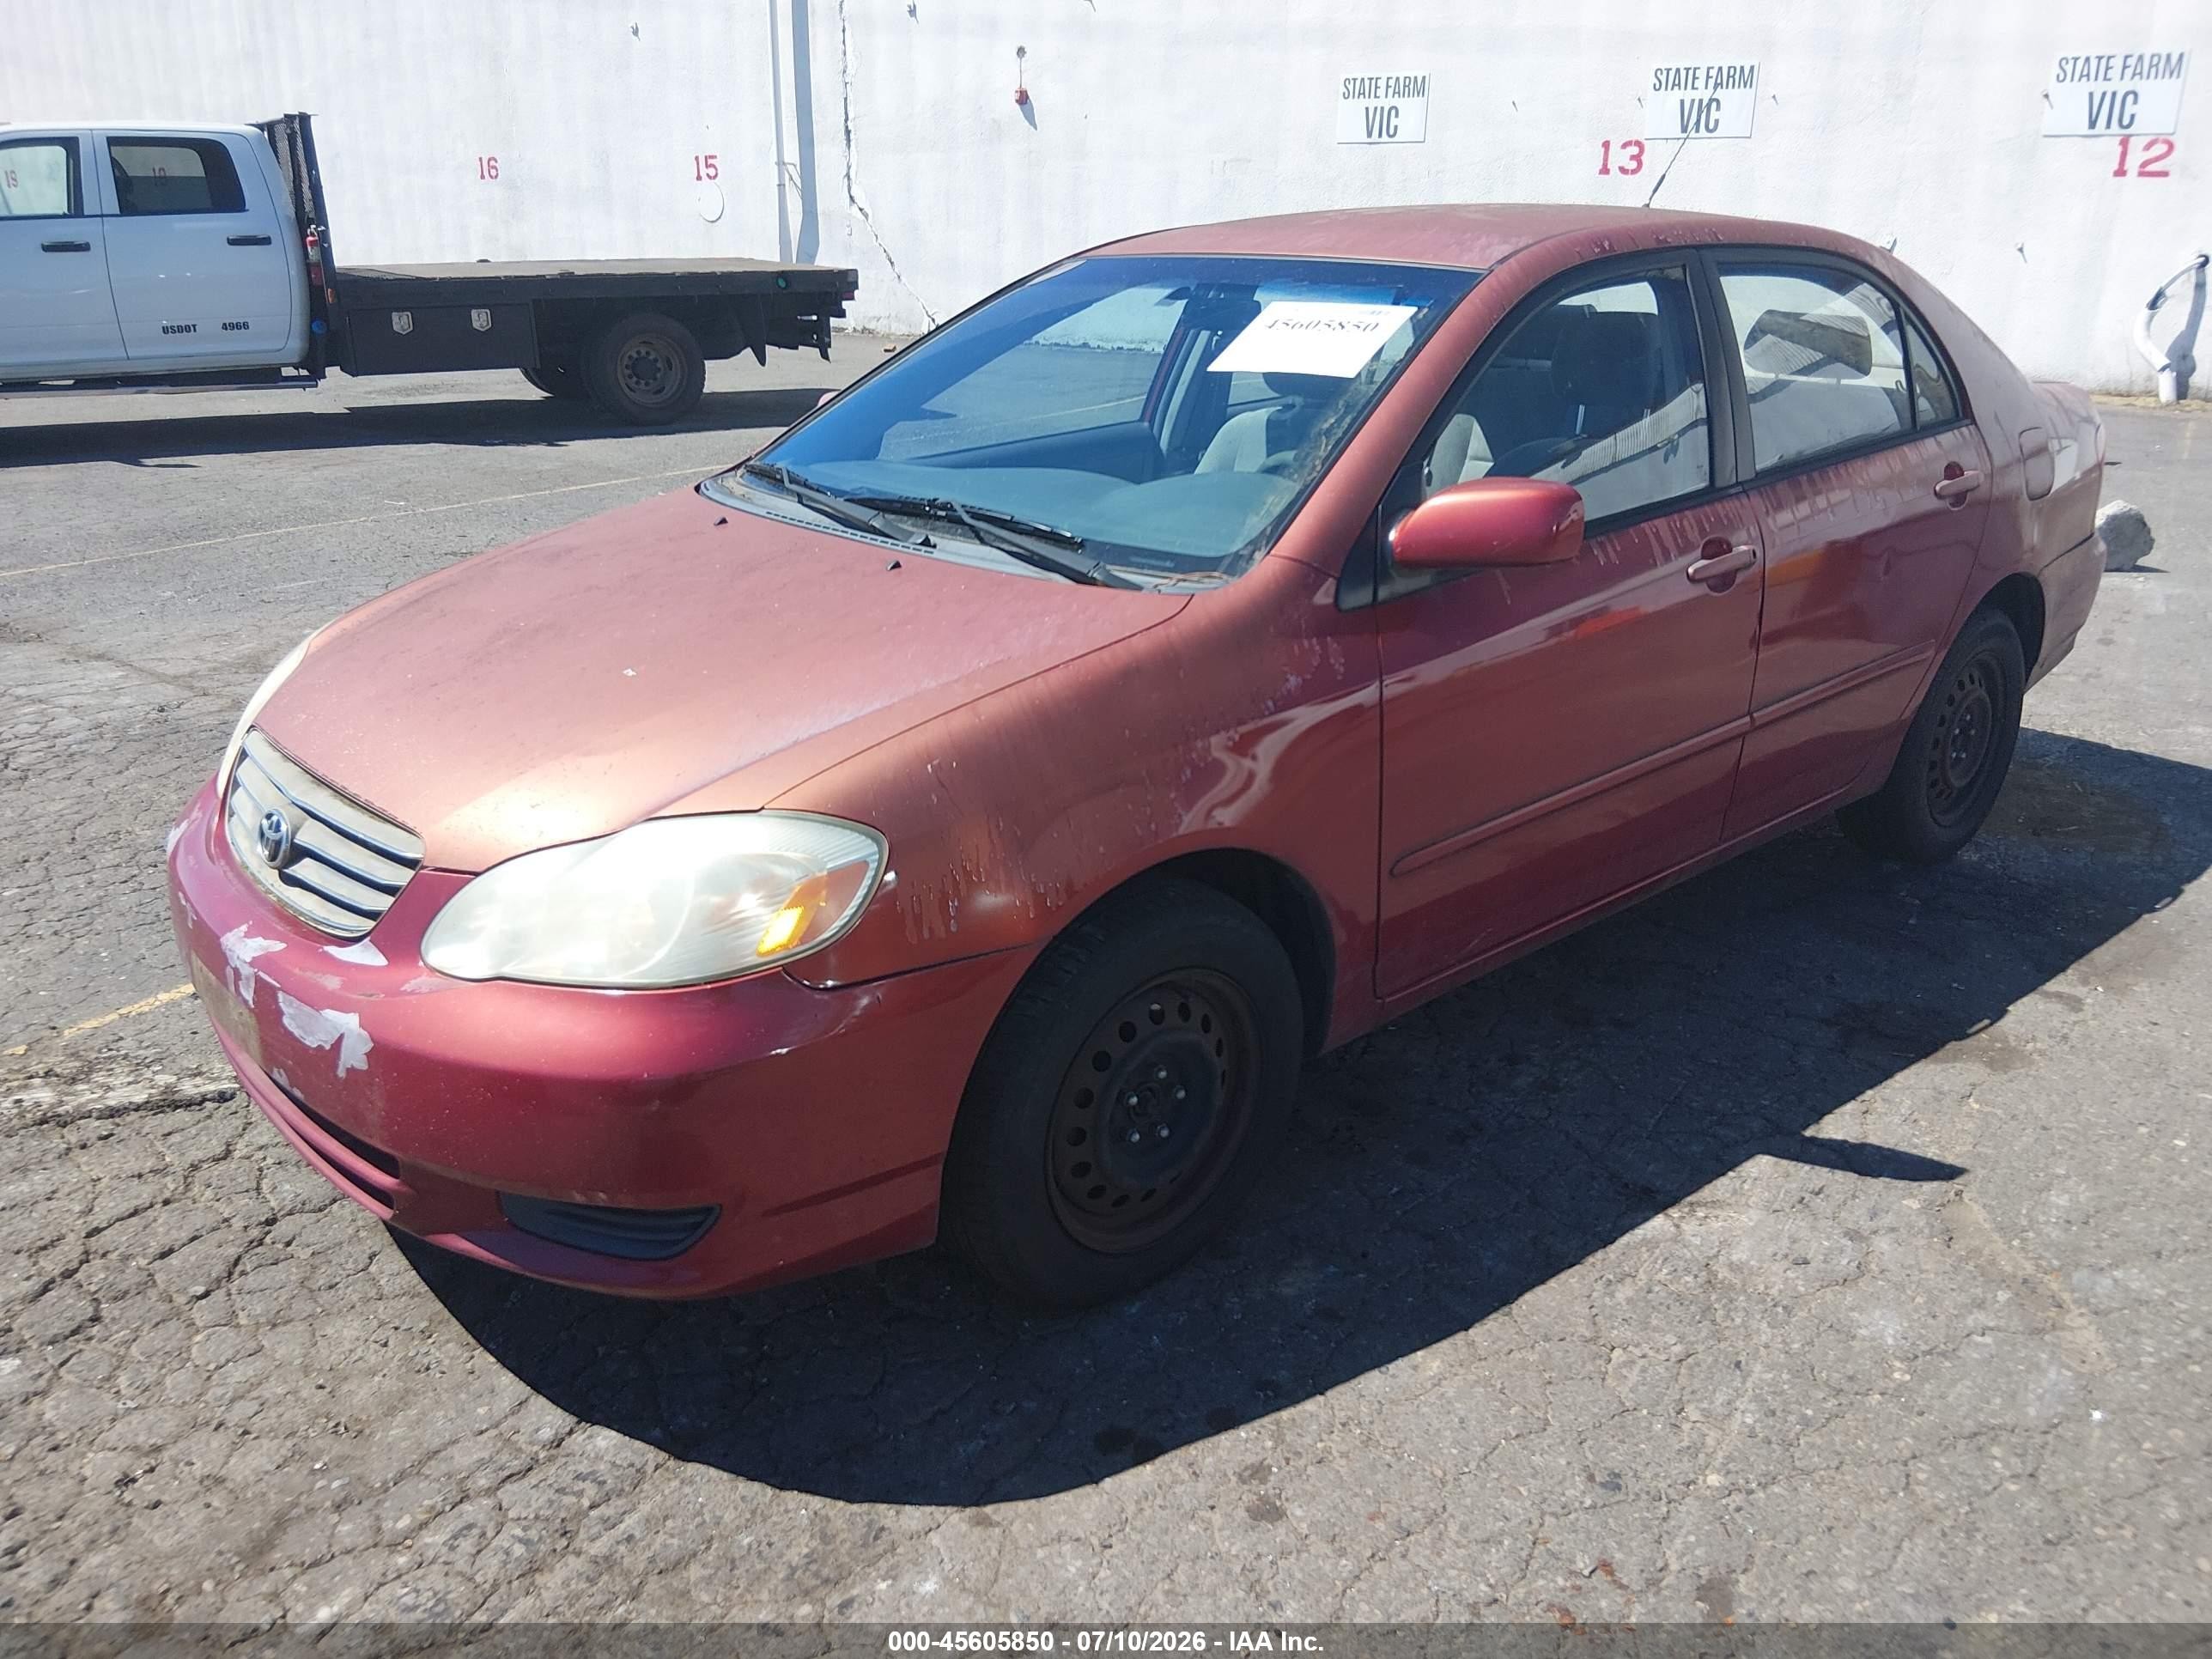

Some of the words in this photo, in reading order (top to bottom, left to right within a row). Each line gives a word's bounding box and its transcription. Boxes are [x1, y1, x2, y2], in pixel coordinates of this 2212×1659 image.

[1653, 67, 1700, 91] STATE
[1705, 64, 1755, 90] FARM
[2057, 55, 2116, 82] STATE
[2119, 52, 2185, 81] FARM
[1342, 77, 1382, 100] STATE
[1385, 75, 1426, 99] FARM
[1364, 105, 1400, 139] VIC
[1680, 97, 1721, 134] VIC
[2087, 89, 2139, 131] VIC
[478, 156, 499, 179] 16
[694, 155, 719, 181] 15
[1598, 139, 1645, 175] 13
[2112, 135, 2175, 178] 12
[161, 324, 198, 335] USDOT
